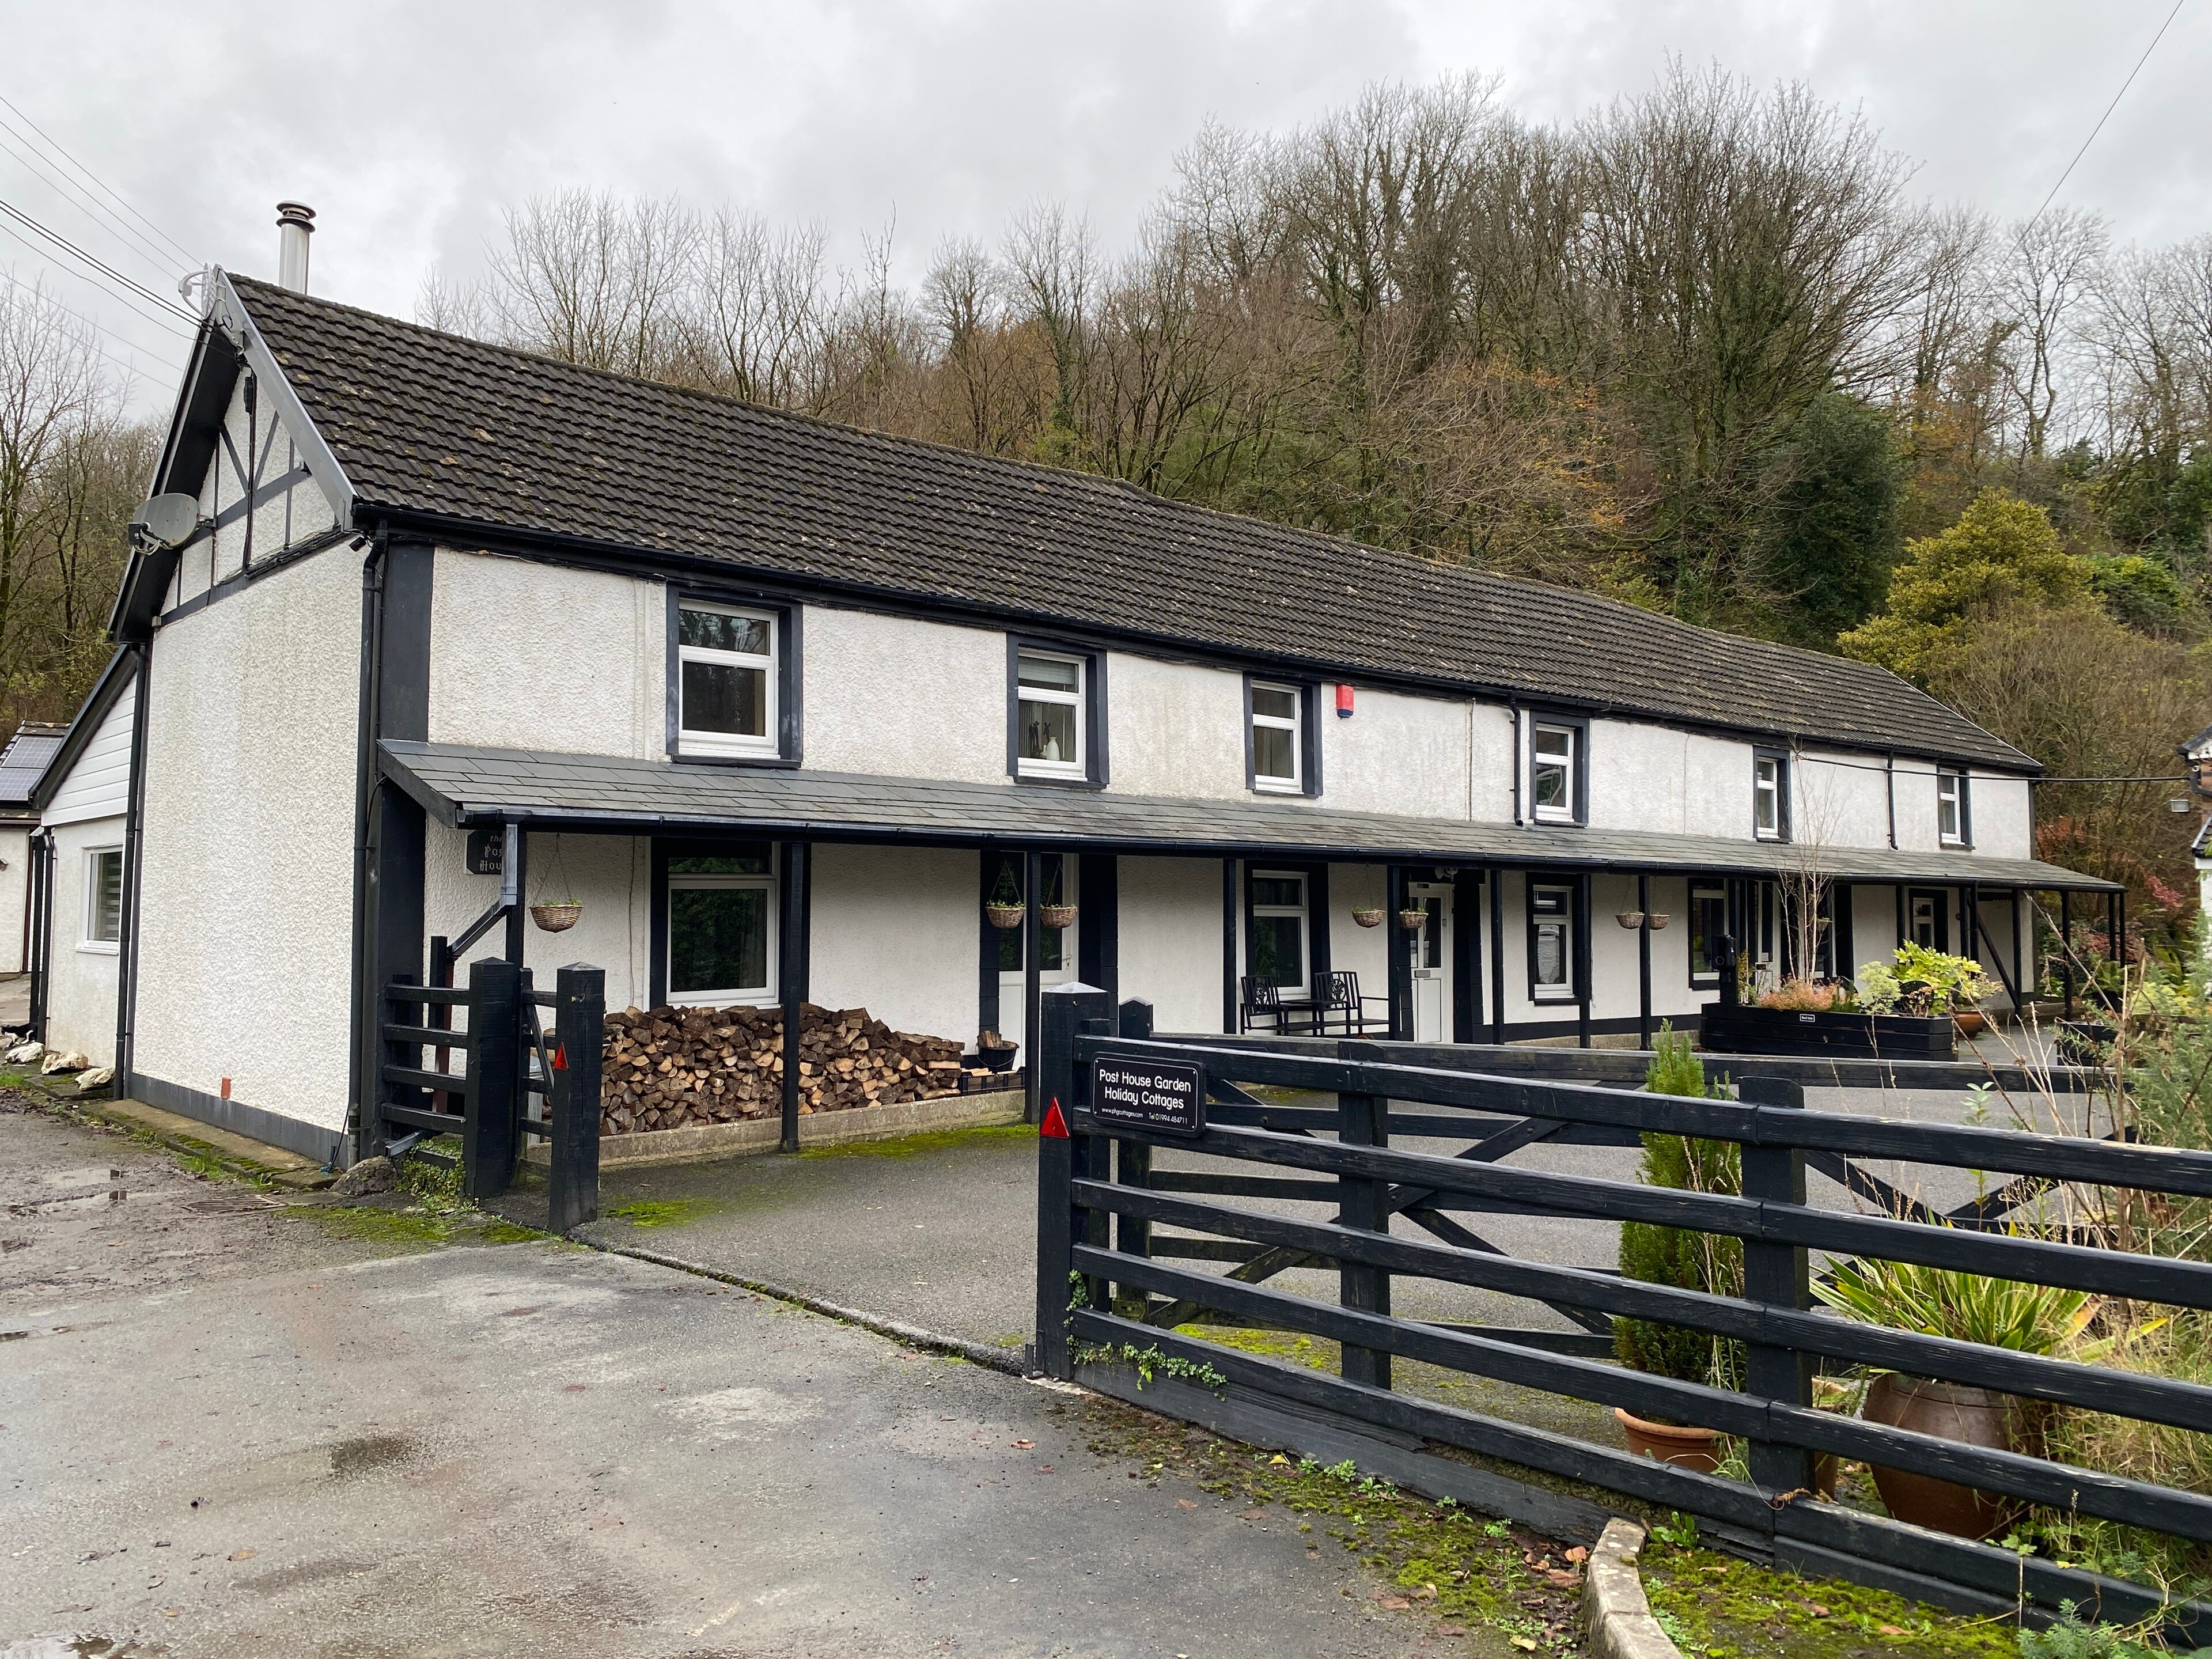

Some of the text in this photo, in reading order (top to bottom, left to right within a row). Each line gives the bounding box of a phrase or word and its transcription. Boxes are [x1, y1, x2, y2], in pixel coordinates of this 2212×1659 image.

[484, 844, 502, 858] Pos
[479, 859, 501, 872] Hou
[1099, 1069, 1191, 1093] Post House Garden
[1104, 1086, 1184, 1110] Holiday Cottages
[1155, 1113, 1170, 1122] 01994
[1171, 1116, 1187, 1124] 484711
